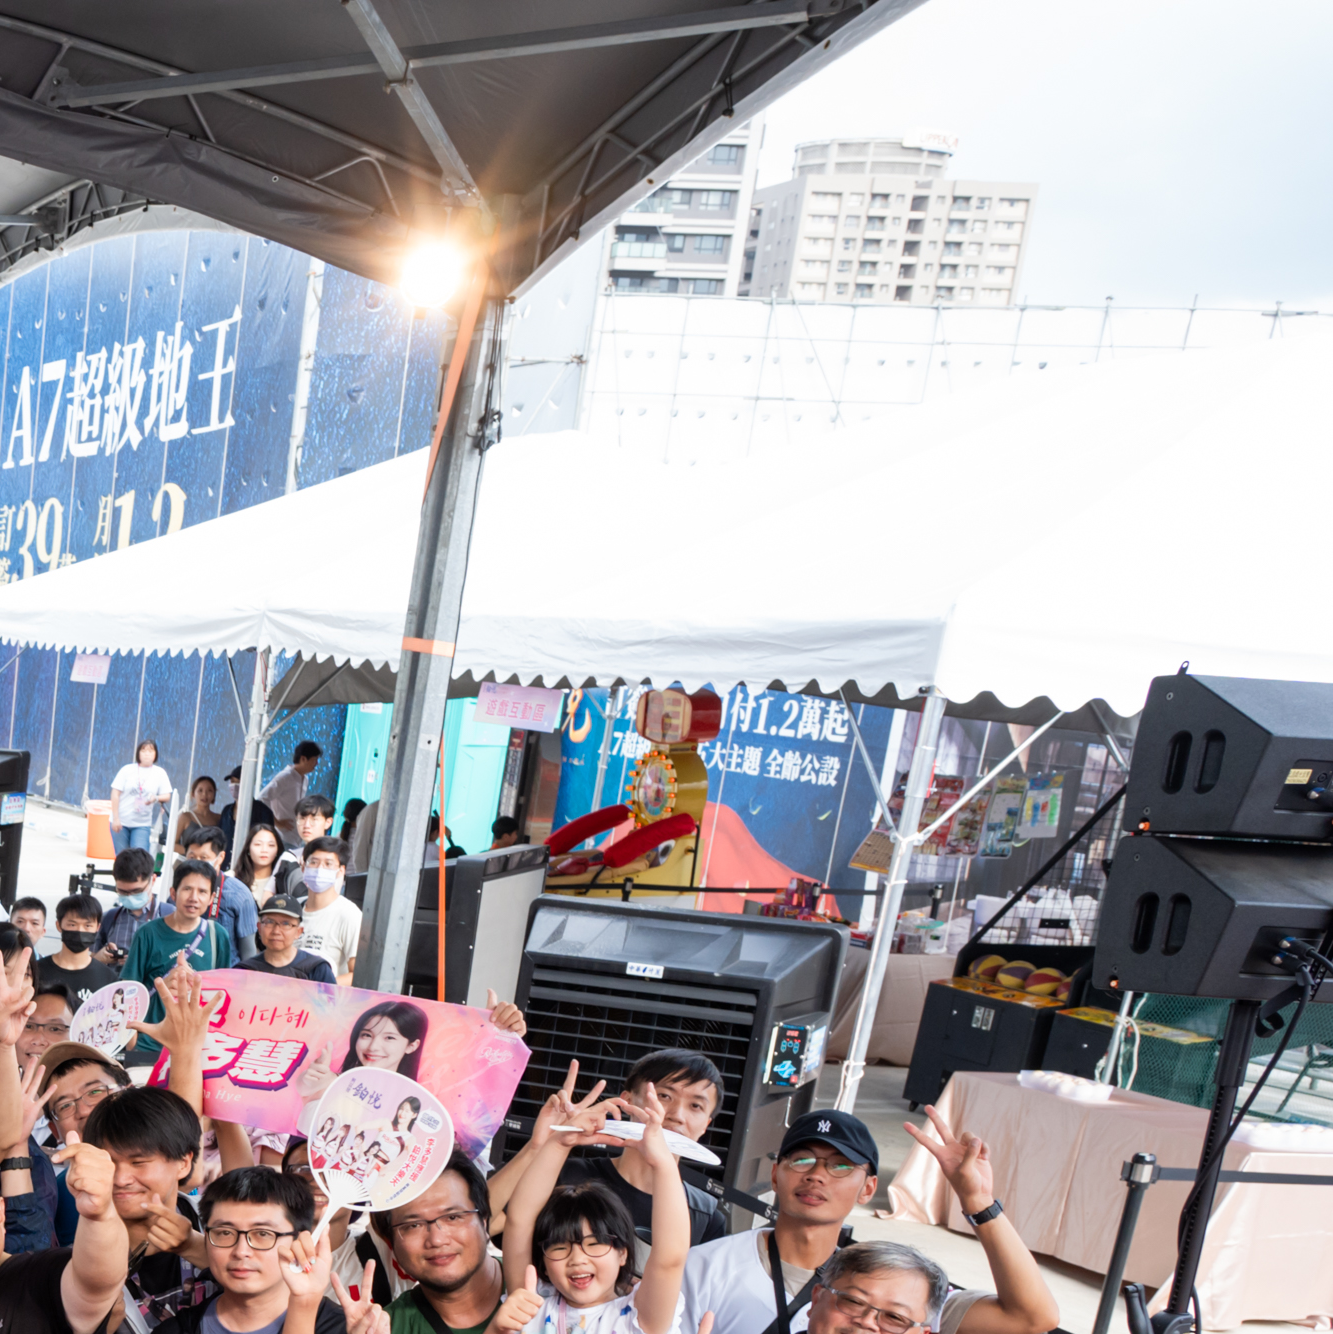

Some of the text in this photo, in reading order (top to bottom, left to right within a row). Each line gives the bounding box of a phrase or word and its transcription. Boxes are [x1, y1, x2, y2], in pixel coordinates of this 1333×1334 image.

[2, 304, 243, 470] A7超級地王
[763, 749, 841, 788] 全齡公設
[238, 1005, 310, 1029] 이다혜
